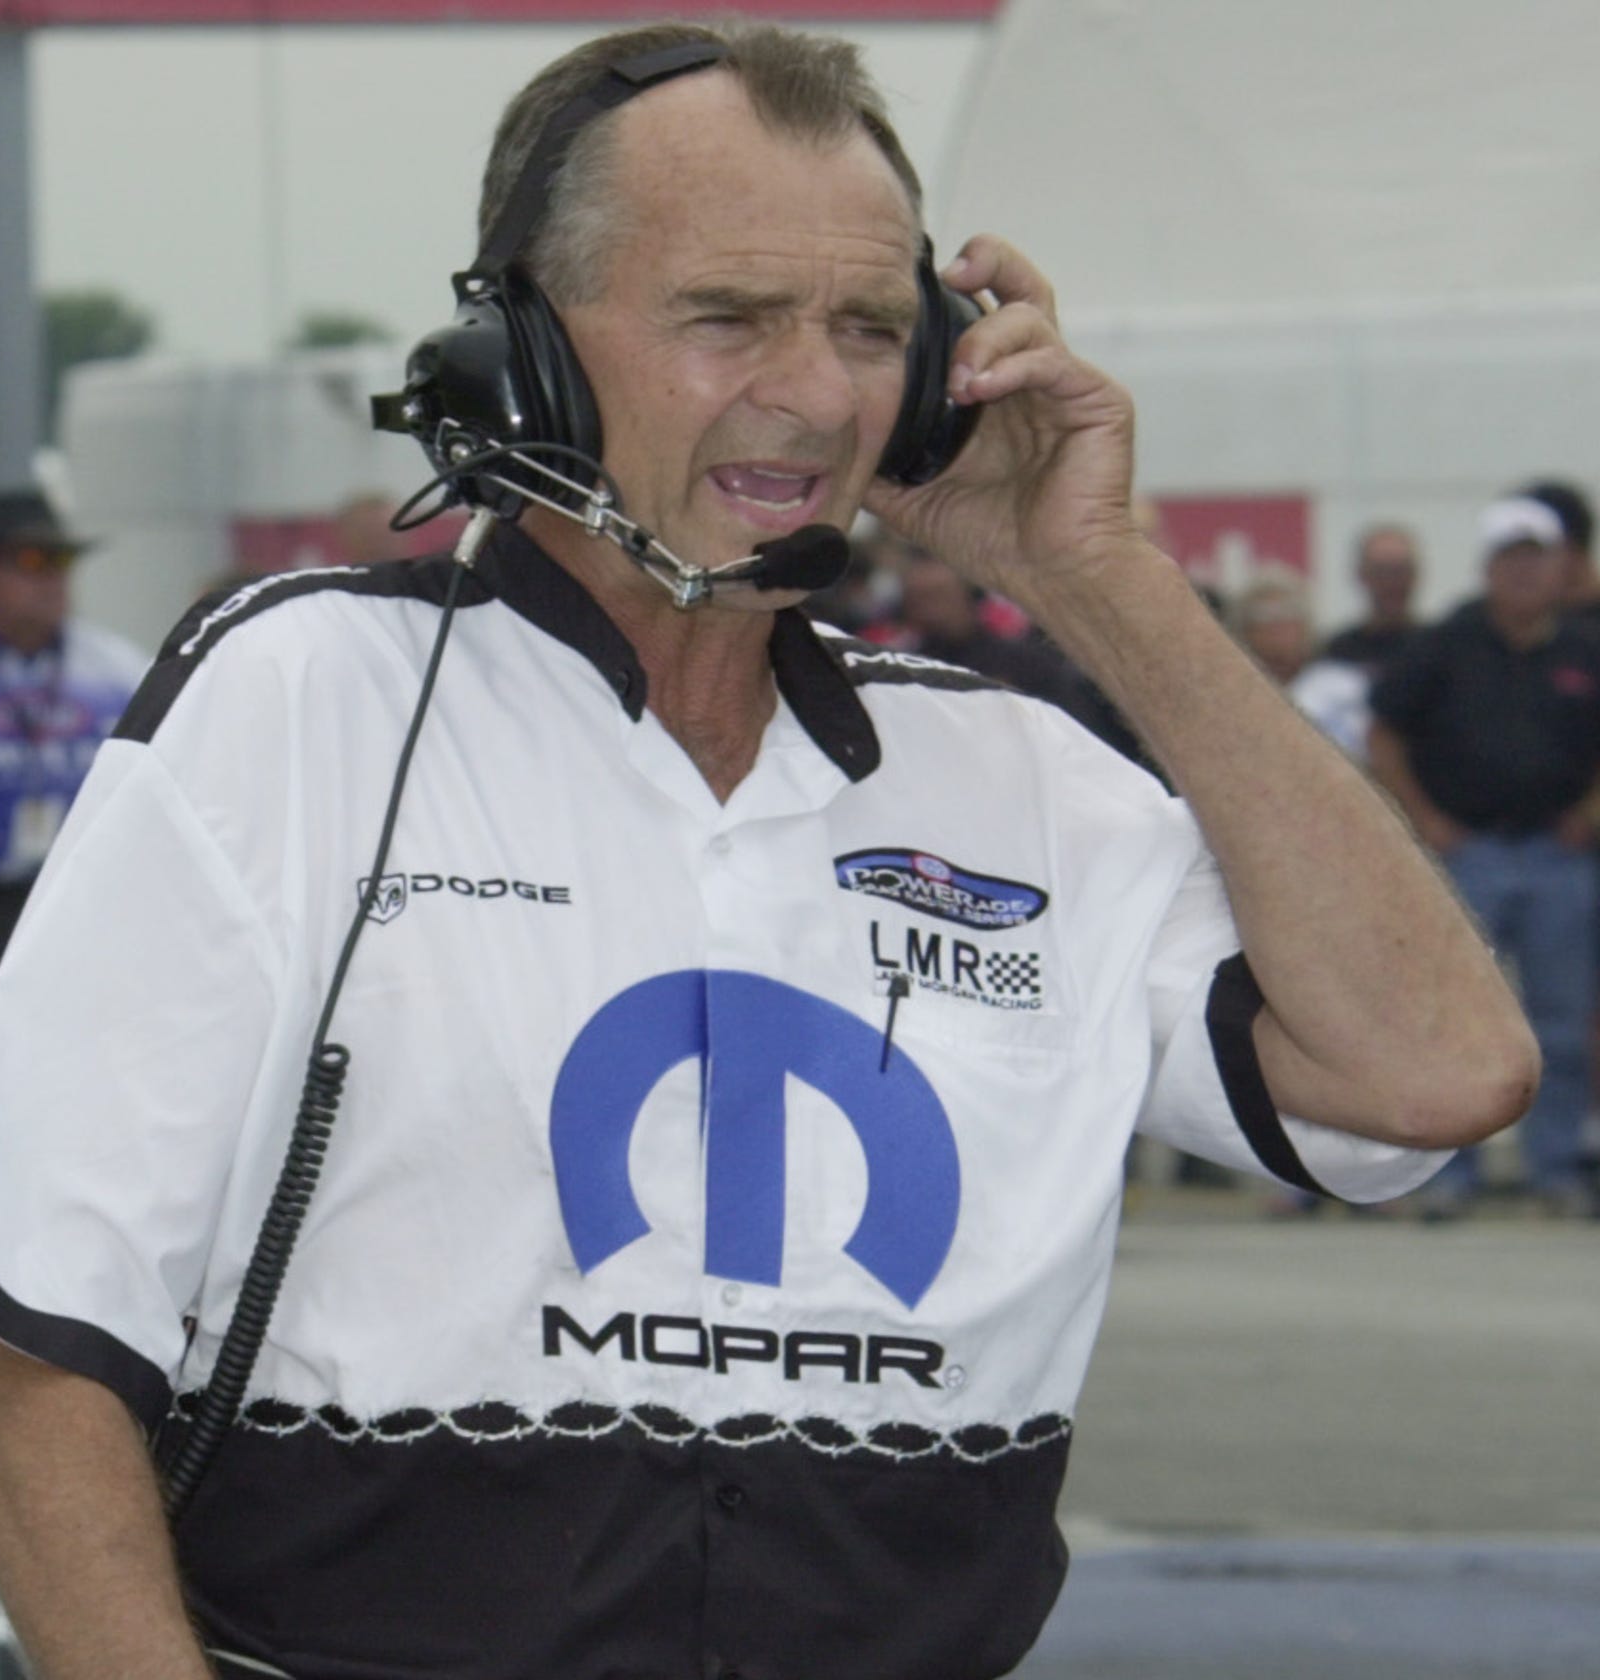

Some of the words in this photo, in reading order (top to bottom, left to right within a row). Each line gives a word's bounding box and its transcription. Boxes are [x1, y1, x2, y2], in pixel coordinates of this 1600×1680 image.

[410, 873, 572, 904] DODGE
[845, 867, 1029, 914] POWERADE
[871, 920, 983, 992] LMR
[980, 993, 1043, 1011] RACING
[541, 1304, 946, 1389] MOPAR
